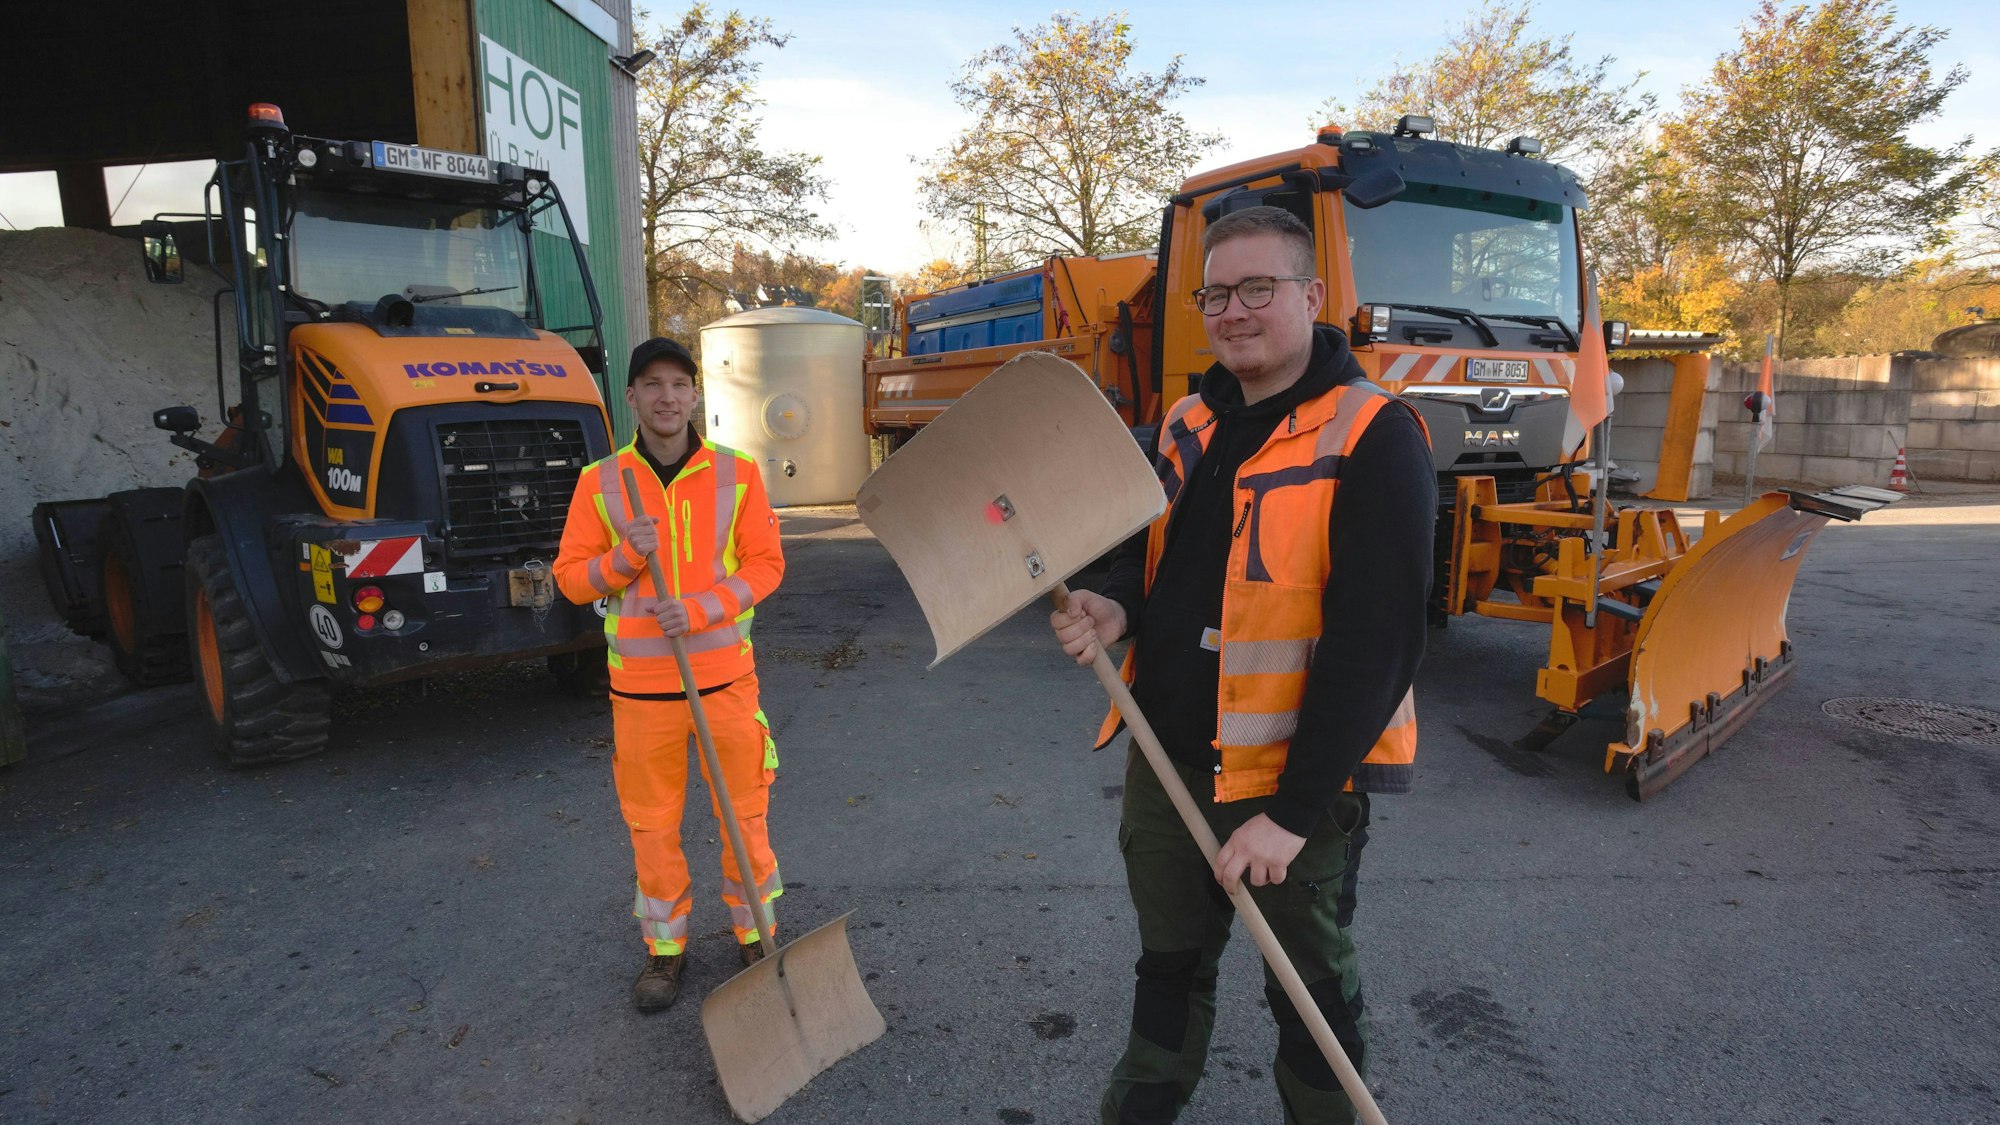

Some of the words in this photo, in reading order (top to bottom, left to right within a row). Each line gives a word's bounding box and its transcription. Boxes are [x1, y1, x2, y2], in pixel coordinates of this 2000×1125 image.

[481, 41, 579, 150] HOF
[386, 147, 409, 167] GM
[421, 151, 442, 171] WF
[447, 155, 486, 177] 8044
[403, 360, 567, 378] KOMATSU
[1473, 361, 1486, 377] GM
[1492, 362, 1504, 377] WF
[1505, 363, 1527, 378] 8051
[1463, 430, 1519, 447] MAN
[327, 447, 344, 465] WA
[327, 467, 362, 493] 100M
[316, 612, 338, 641] 40
